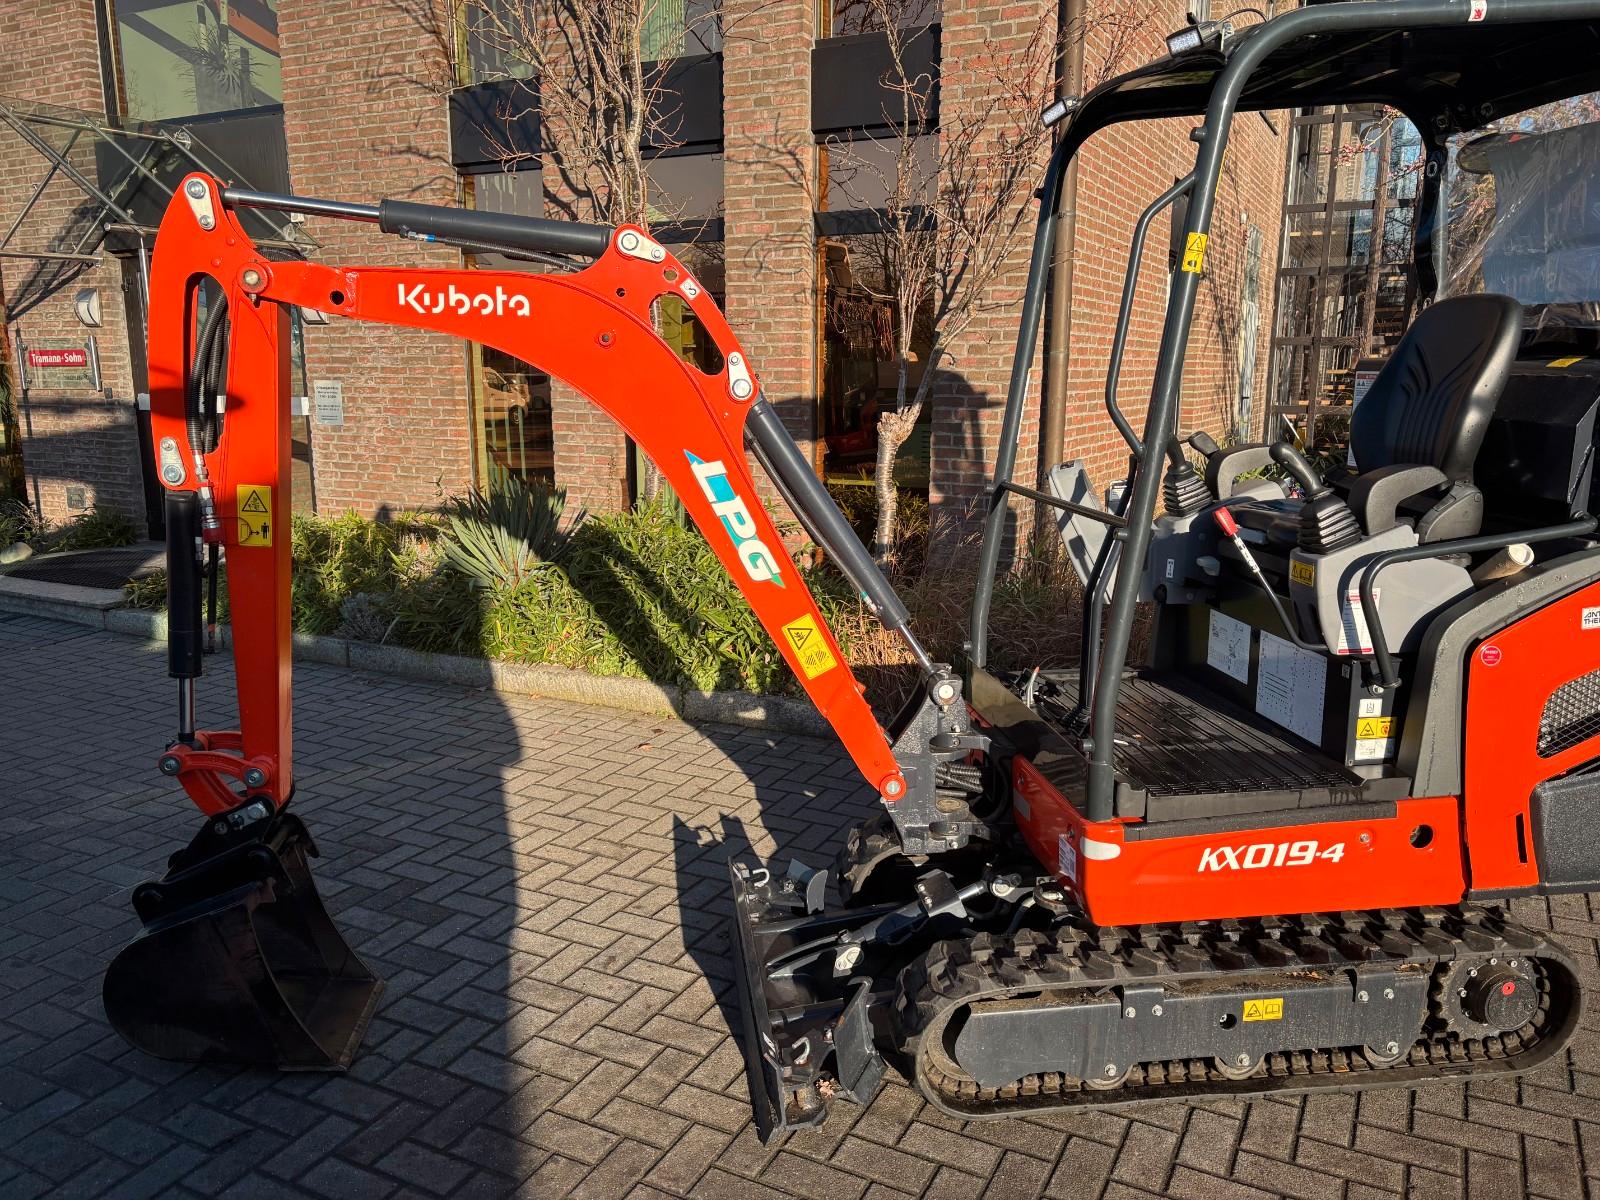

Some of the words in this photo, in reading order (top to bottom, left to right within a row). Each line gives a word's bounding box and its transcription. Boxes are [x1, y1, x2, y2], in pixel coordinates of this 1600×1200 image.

[398, 283, 530, 316] Kubota
[690, 460, 781, 582] LPG
[1198, 840, 1345, 872] KX019-4
